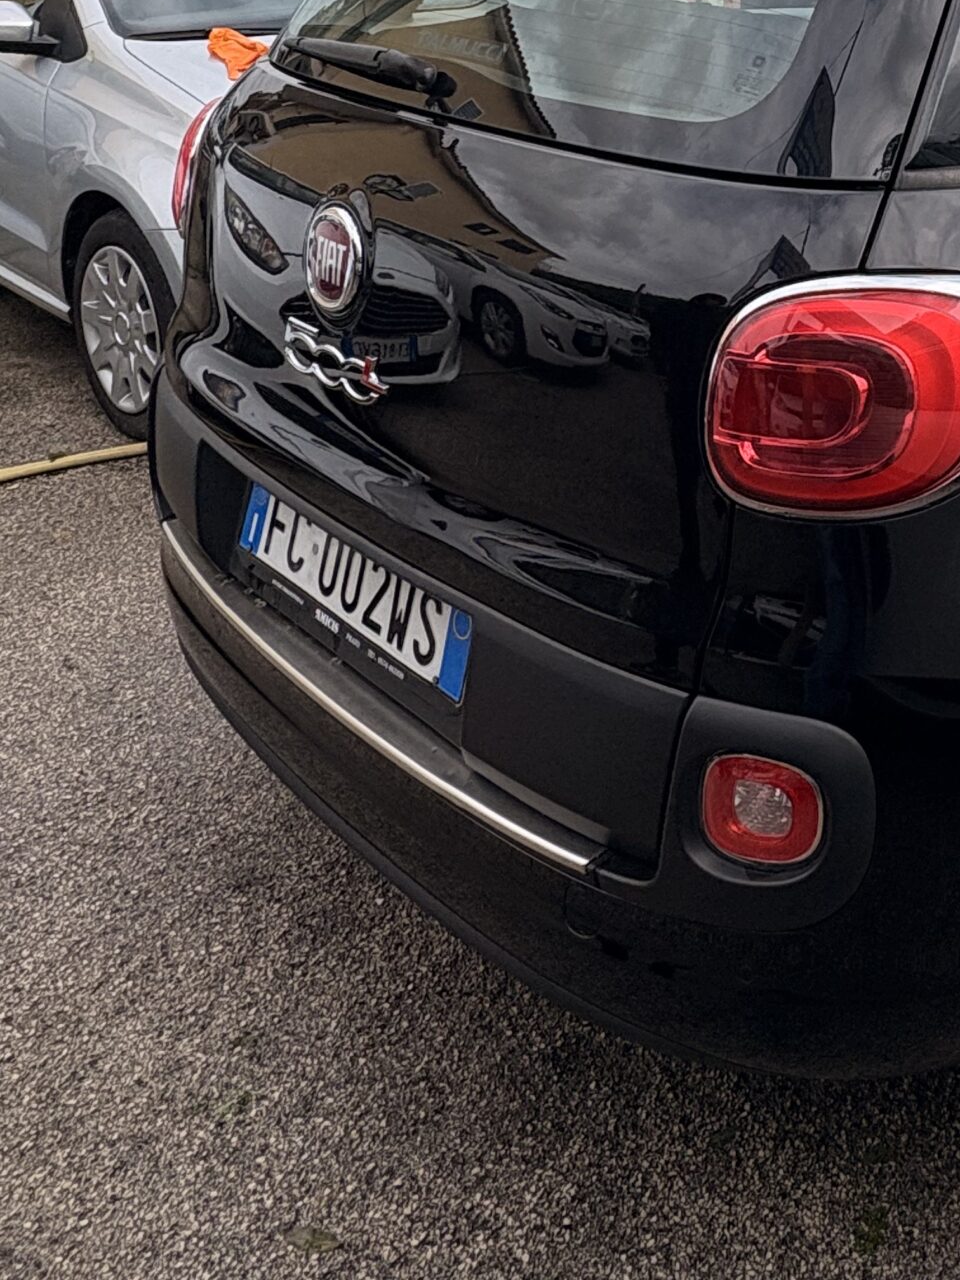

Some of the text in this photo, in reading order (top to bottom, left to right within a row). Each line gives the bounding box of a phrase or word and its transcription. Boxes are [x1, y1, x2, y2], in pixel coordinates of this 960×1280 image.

[315, 235, 347, 287] FIAT
[285, 316, 389, 405] 500L
[248, 512, 258, 543] I
